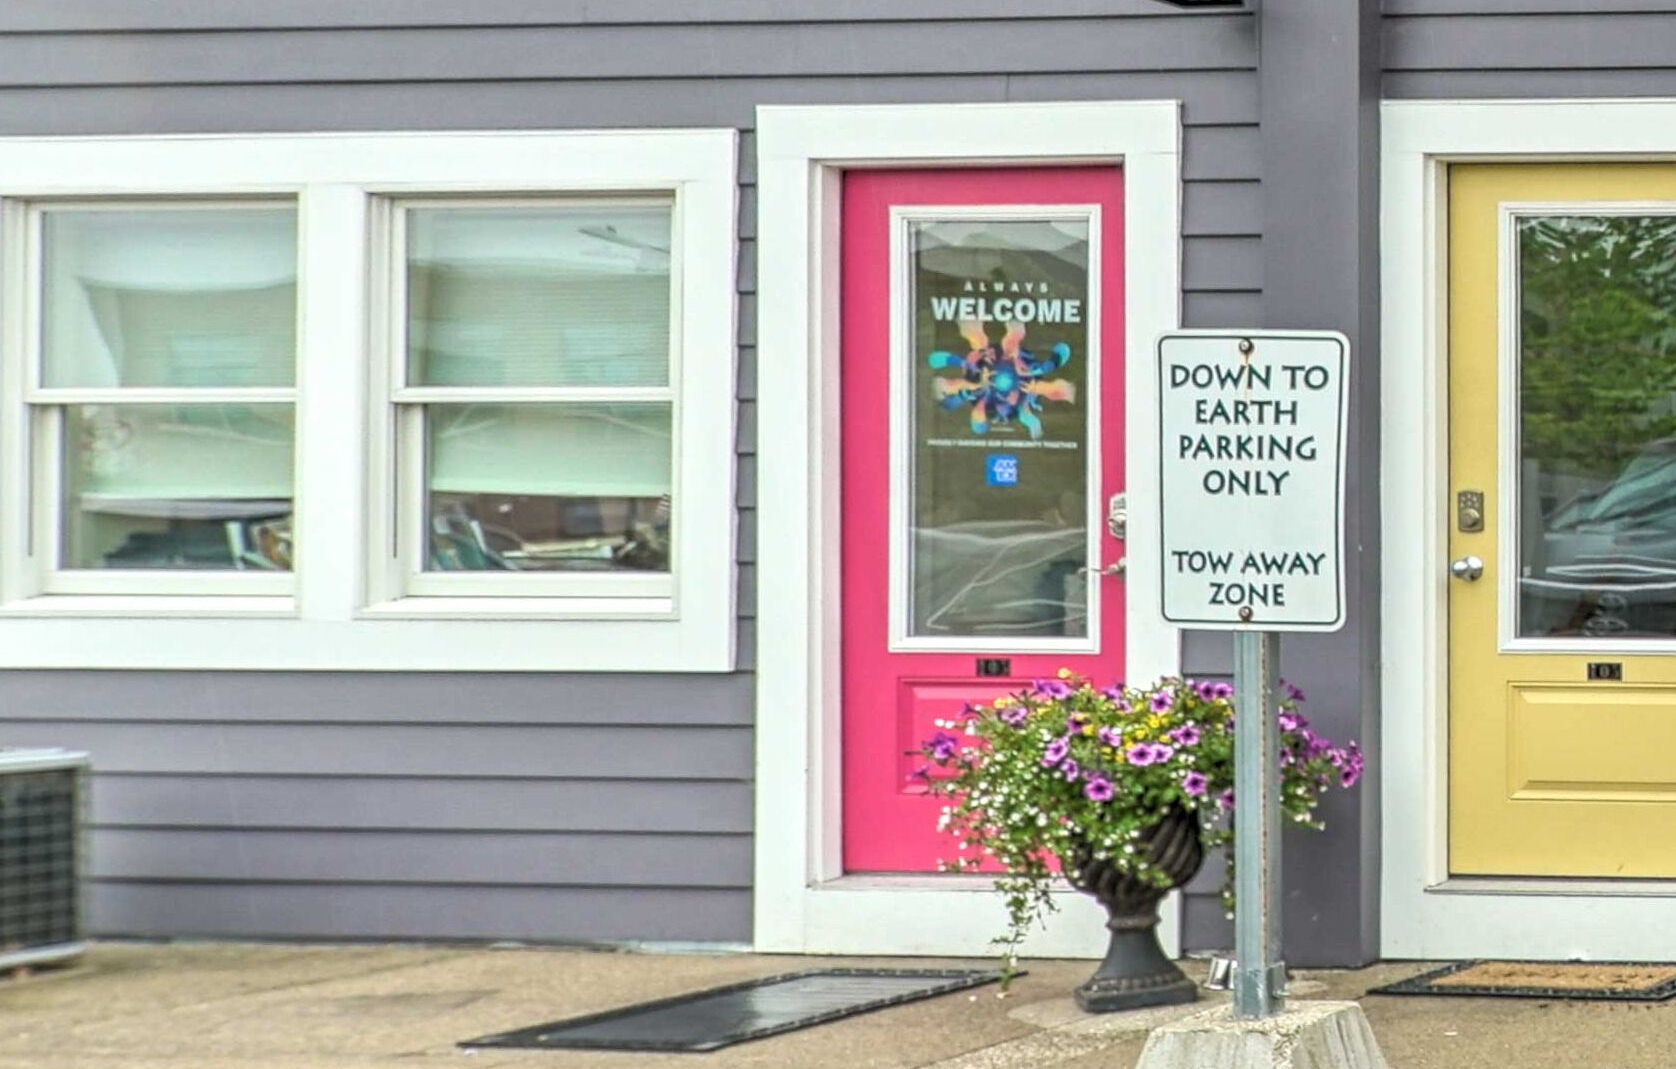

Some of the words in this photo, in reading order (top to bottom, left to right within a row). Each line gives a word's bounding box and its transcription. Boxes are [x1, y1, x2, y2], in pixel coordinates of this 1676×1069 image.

[963, 281, 1048, 293] ALWAYS
[931, 297, 1081, 323] WELCOME
[1172, 364, 1271, 389] DOWN
[1283, 366, 1328, 389] TO
[1197, 400, 1296, 424] EARTH
[1180, 435, 1316, 460] PARKING
[1204, 470, 1289, 495] ONLY
[1172, 551, 1233, 573] TOW
[1241, 553, 1325, 574] AWAY
[1210, 583, 1284, 605] ZONE
